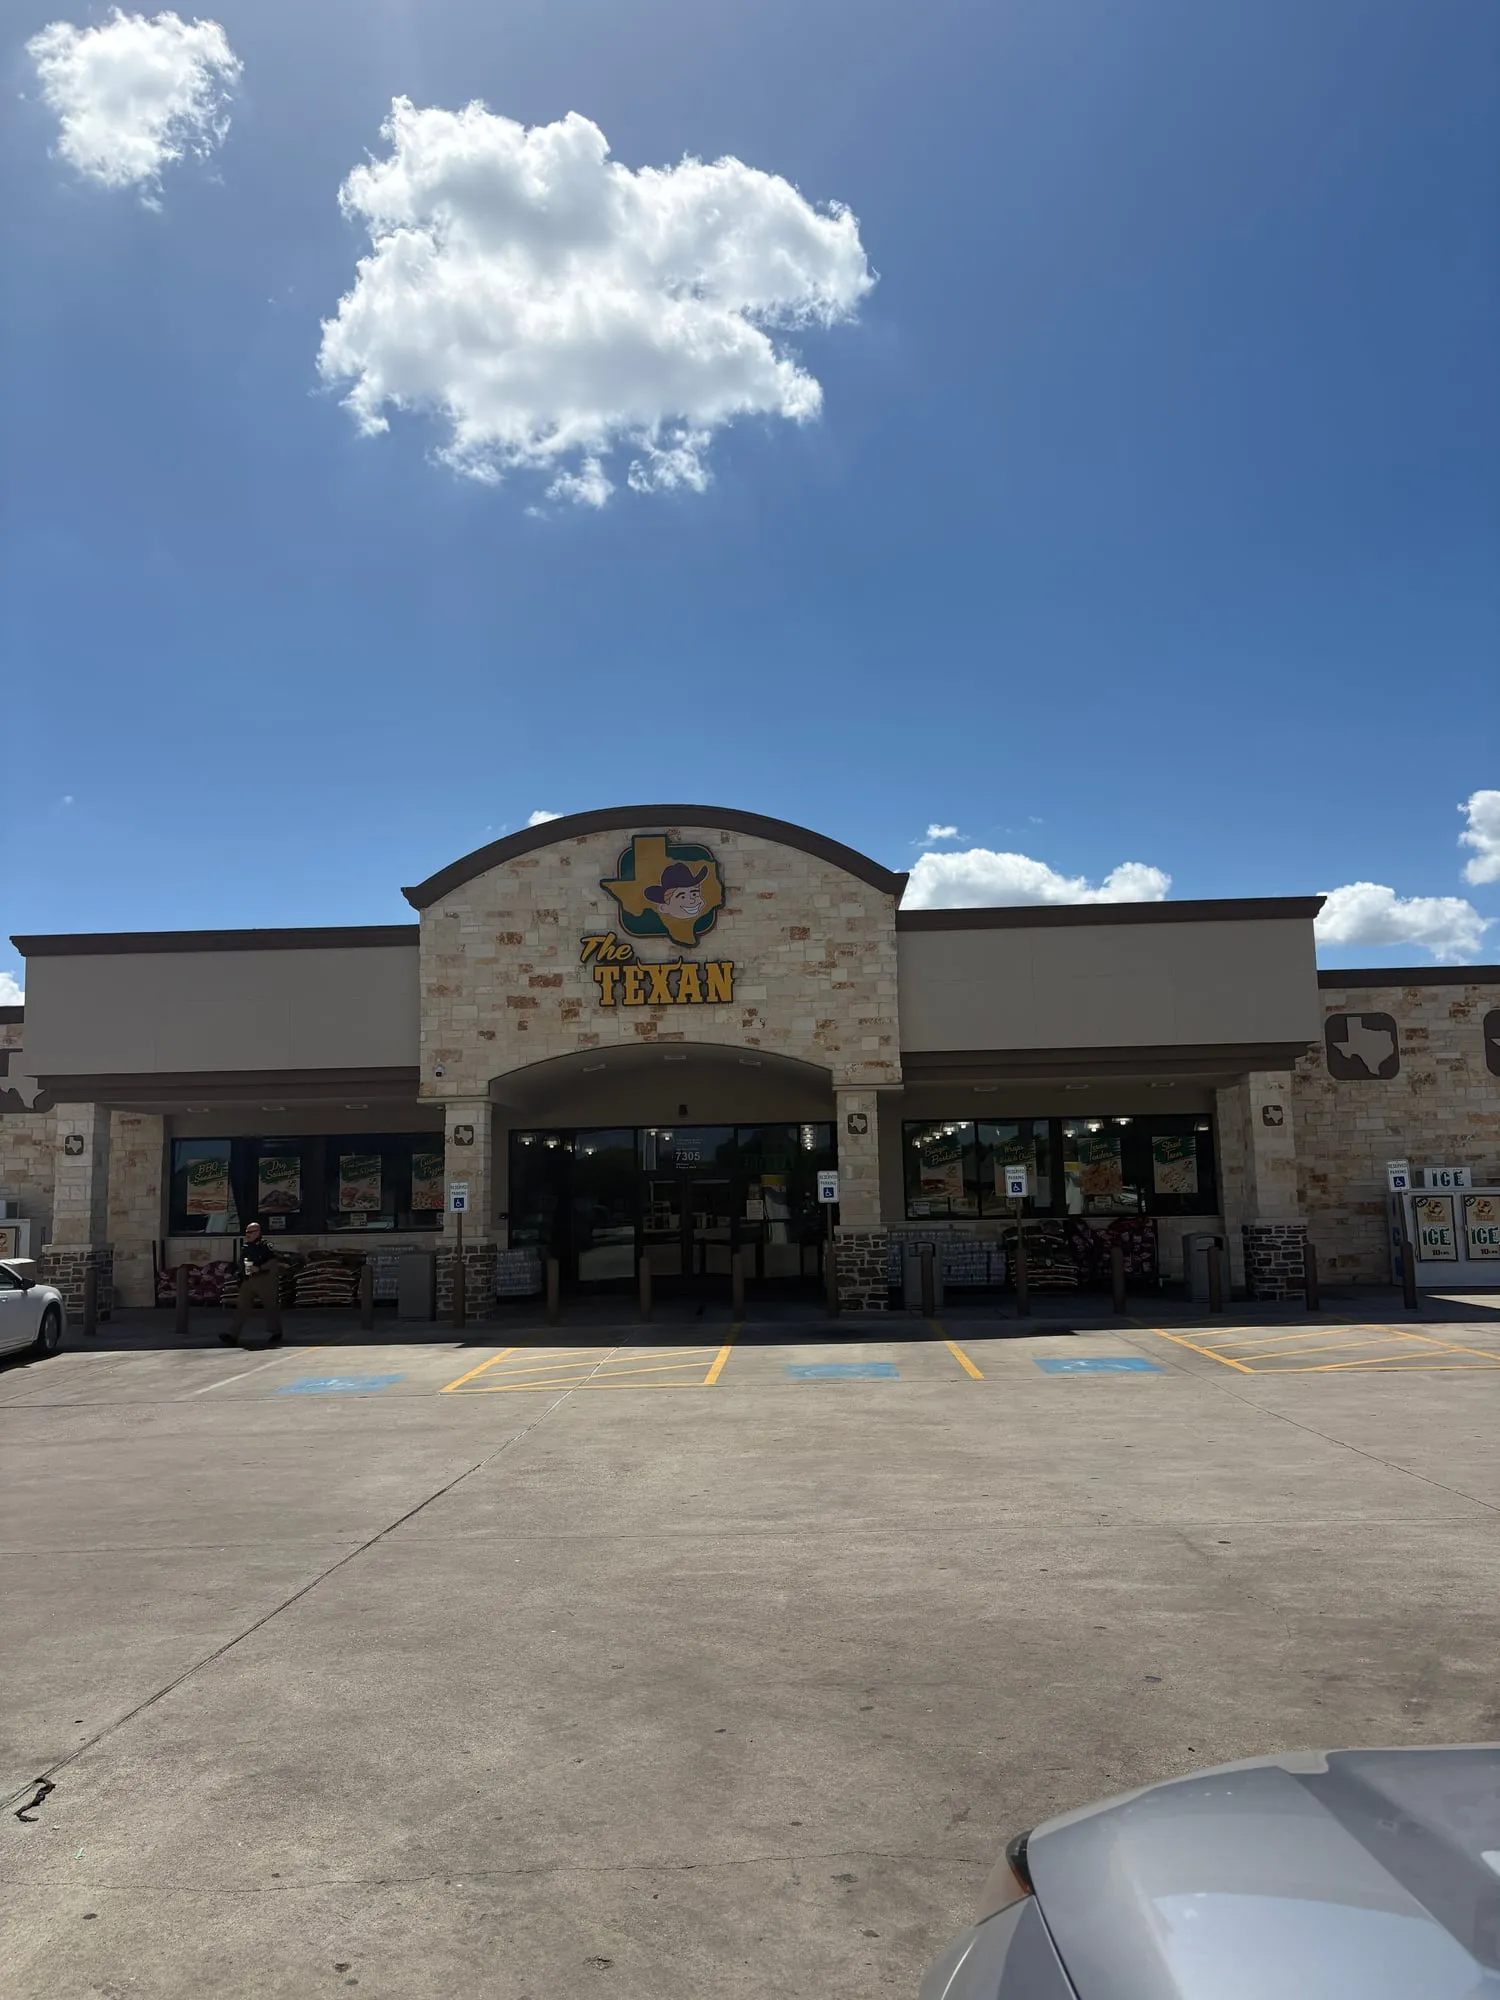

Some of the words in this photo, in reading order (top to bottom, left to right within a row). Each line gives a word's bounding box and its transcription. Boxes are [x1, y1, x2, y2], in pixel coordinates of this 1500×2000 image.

[580, 932, 633, 963] The
[593, 958, 734, 1006] TEXAN
[675, 1151, 701, 1162] 7305
[1432, 1170, 1465, 1187] ICE
[1422, 1225, 1451, 1245] ICE
[1471, 1224, 1500, 1245] ICE
